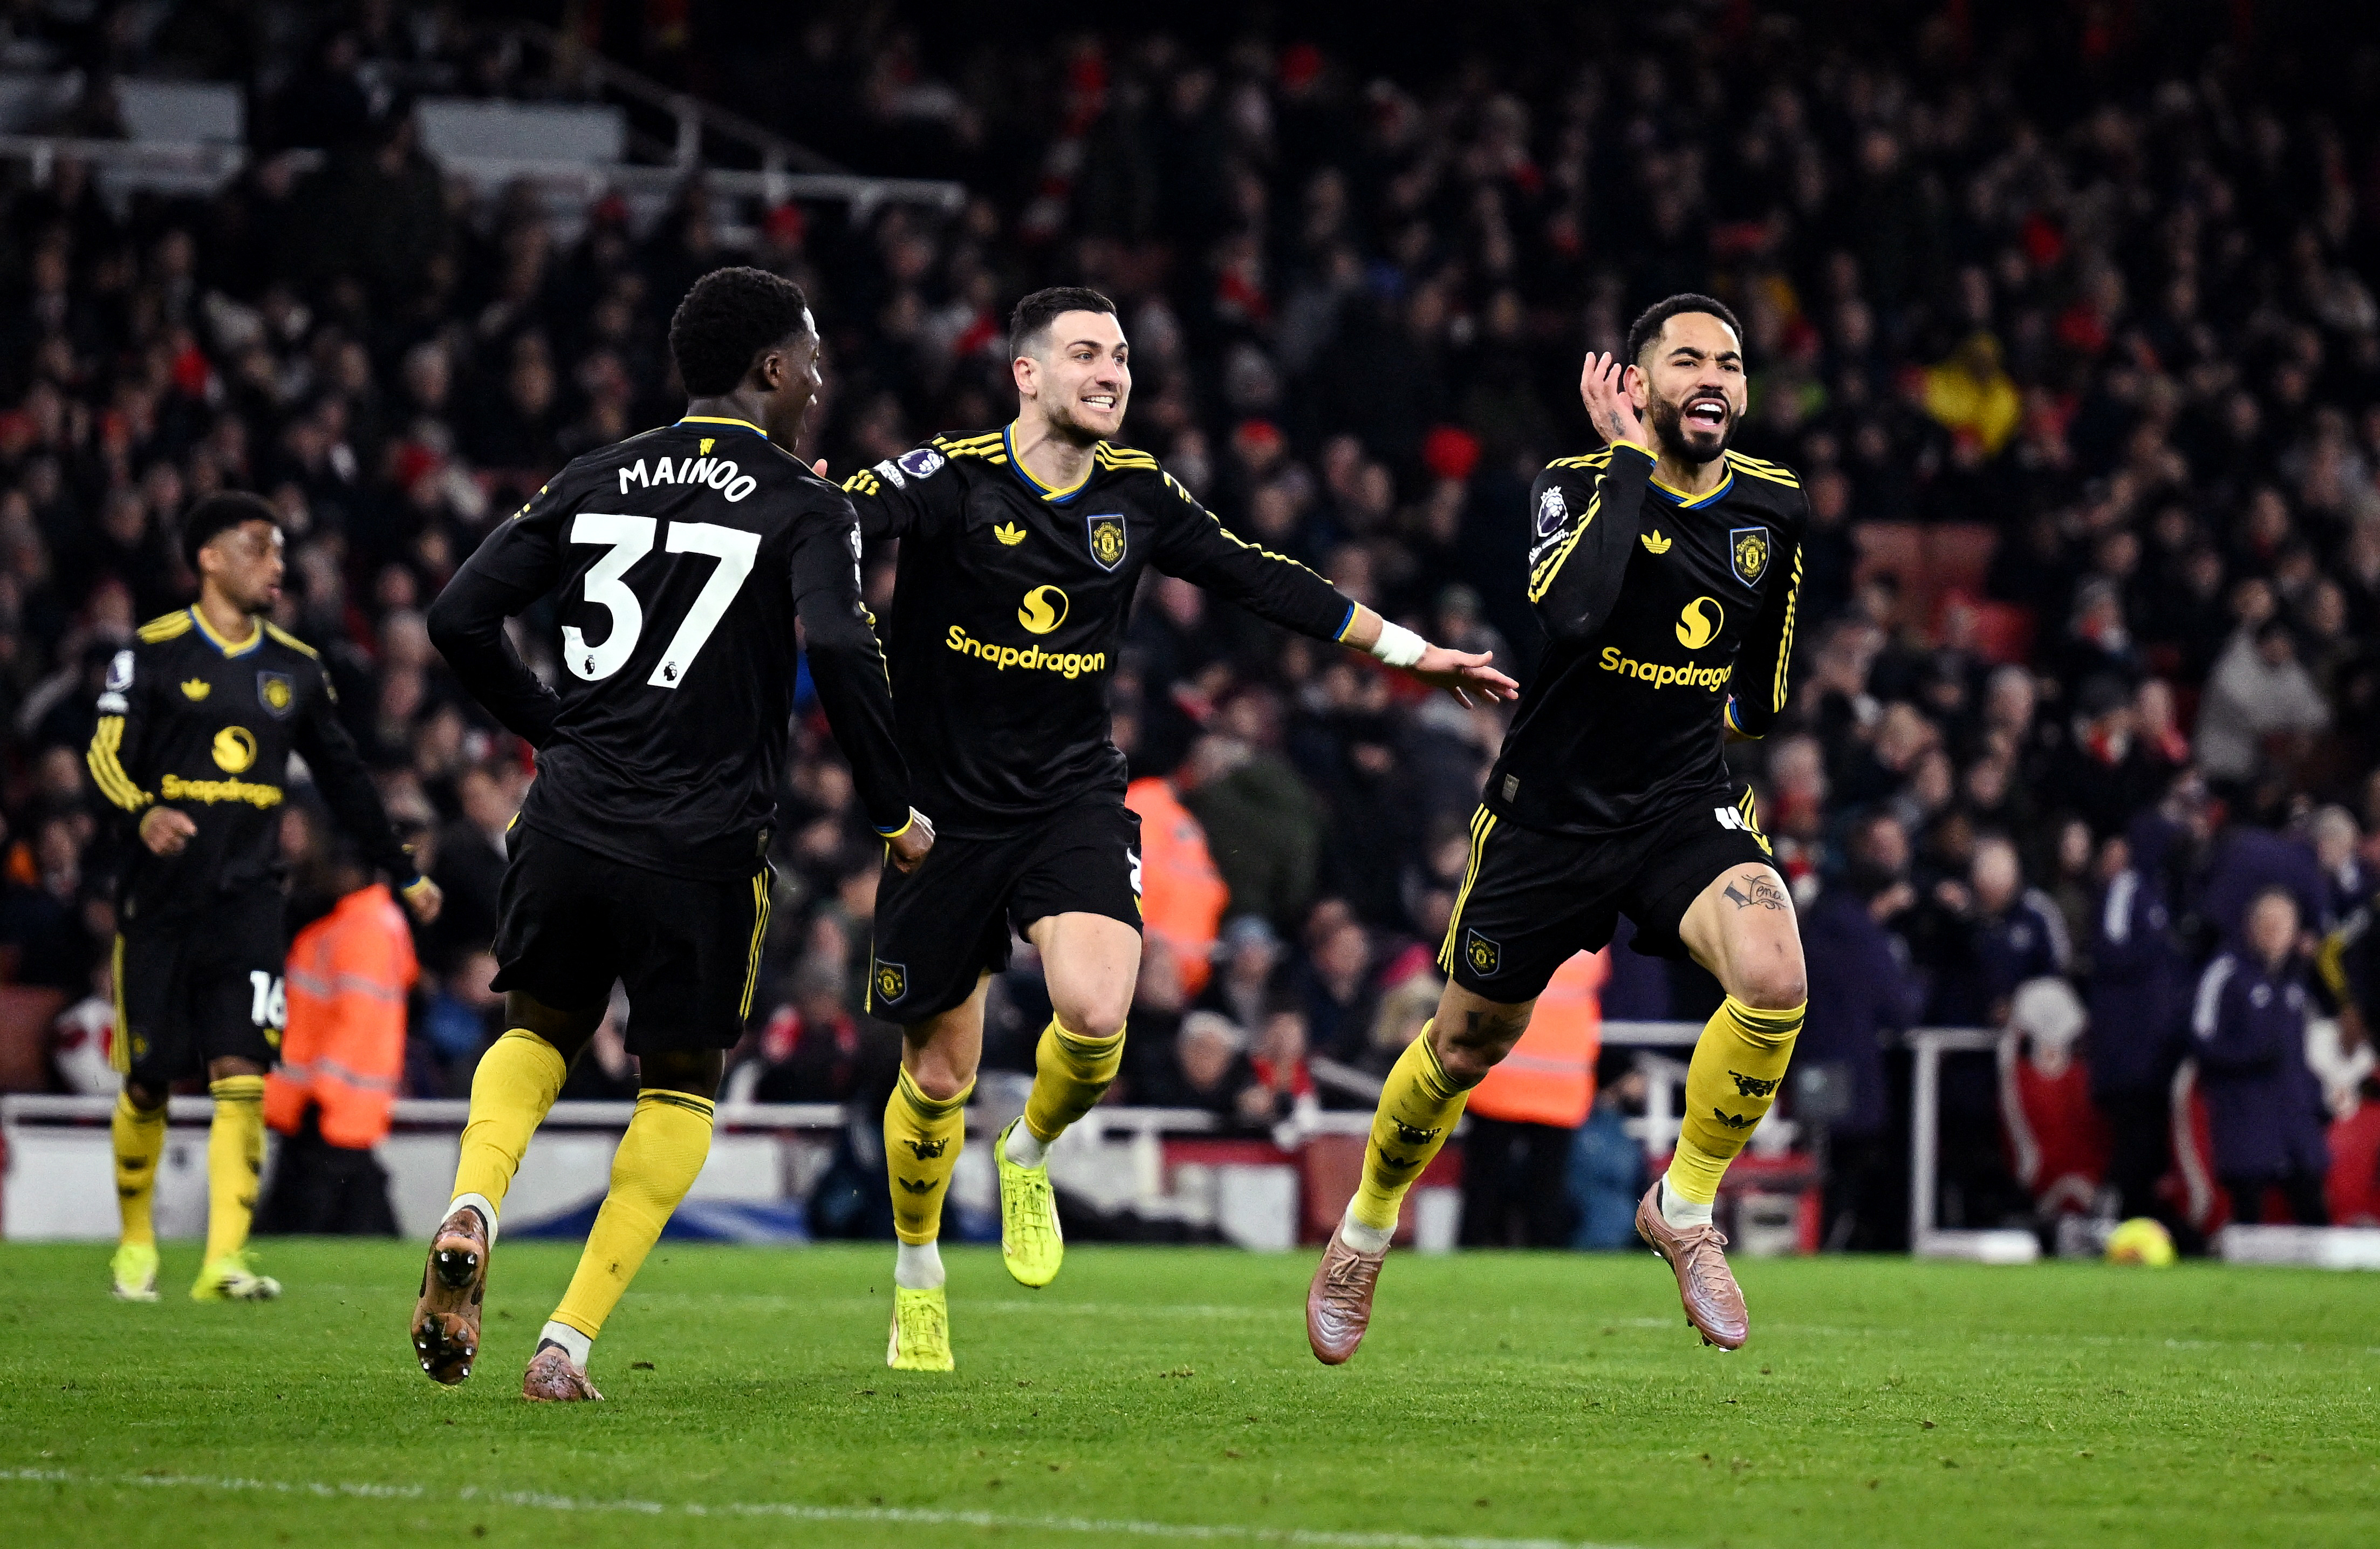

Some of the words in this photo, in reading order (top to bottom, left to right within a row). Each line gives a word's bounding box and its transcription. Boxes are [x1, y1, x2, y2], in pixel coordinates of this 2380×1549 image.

[619, 457, 757, 503] MAINOO
[562, 514, 762, 689] 37
[946, 625, 1105, 679] Snapdragon
[1598, 647, 1732, 692] Snapdrago
[250, 971, 287, 1029] 16
